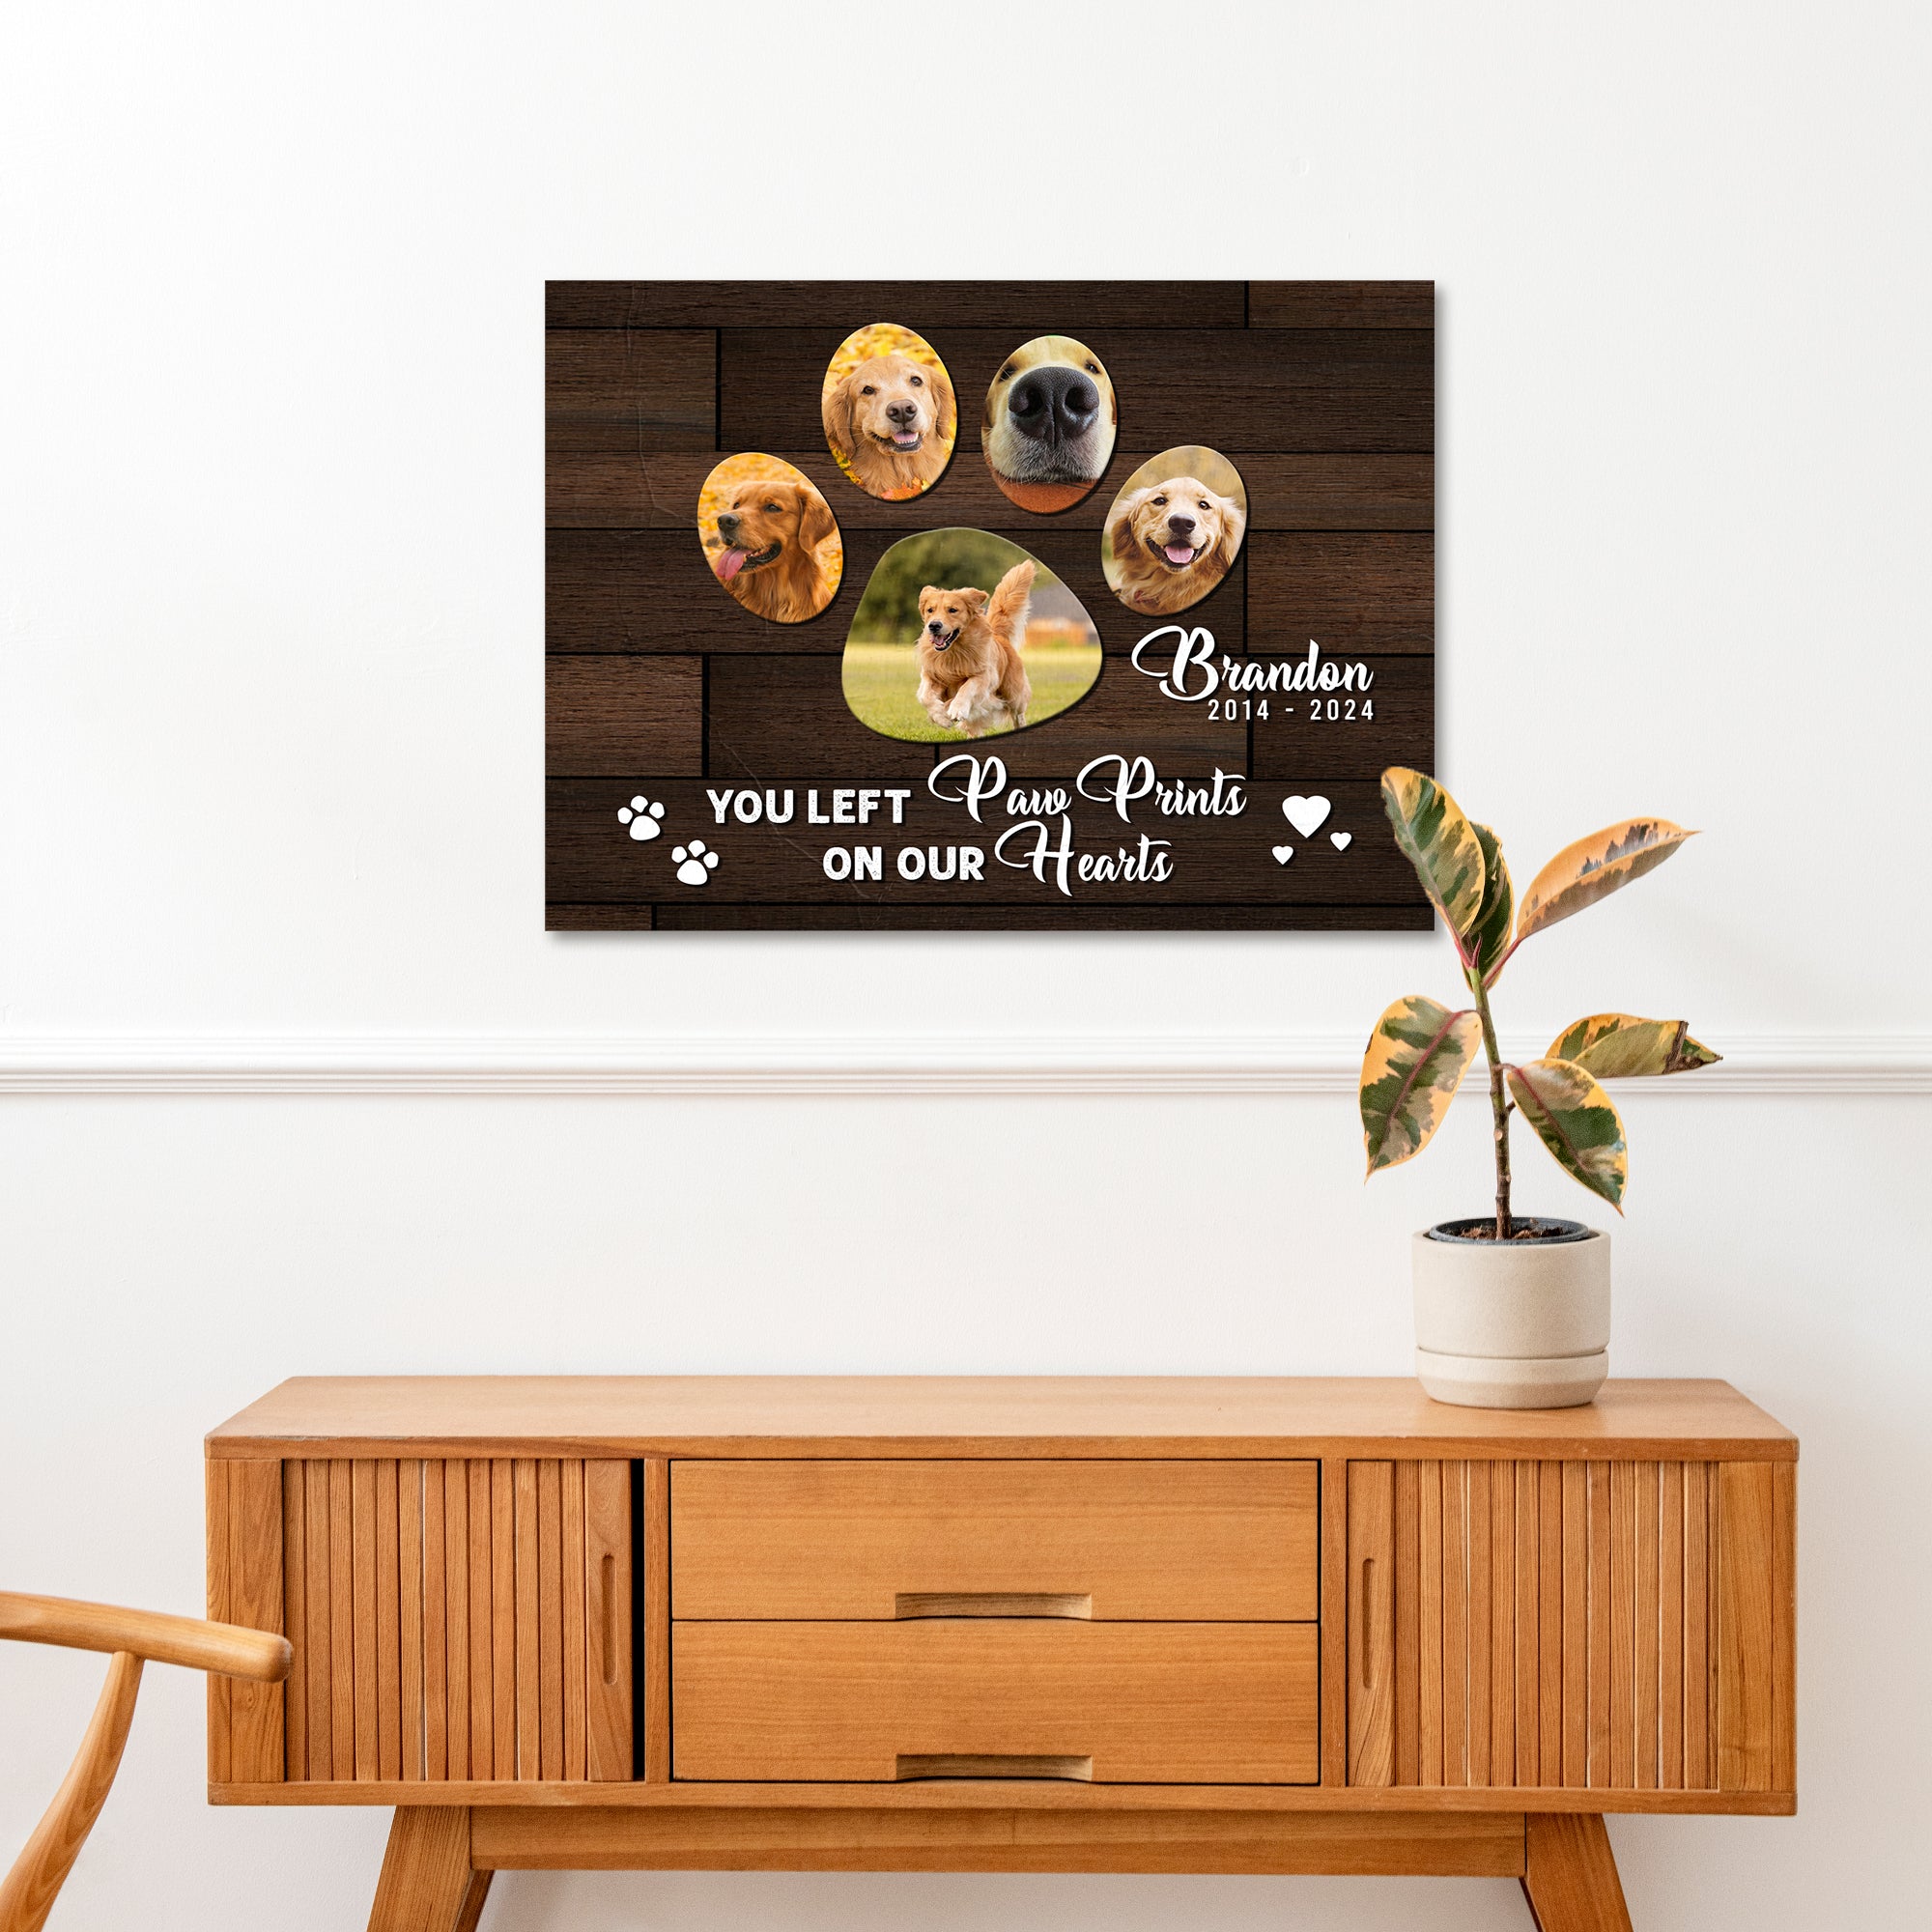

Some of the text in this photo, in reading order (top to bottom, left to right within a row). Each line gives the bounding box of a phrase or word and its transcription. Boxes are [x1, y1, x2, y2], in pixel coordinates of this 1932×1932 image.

[1130, 625, 1374, 701] Brandon
[1208, 698, 1269, 721] 2014
[1310, 698, 1374, 721] 2024
[706, 753, 1247, 824] YOU LEFT Paw Prints
[823, 812, 1174, 896] ON OUR Hearts
